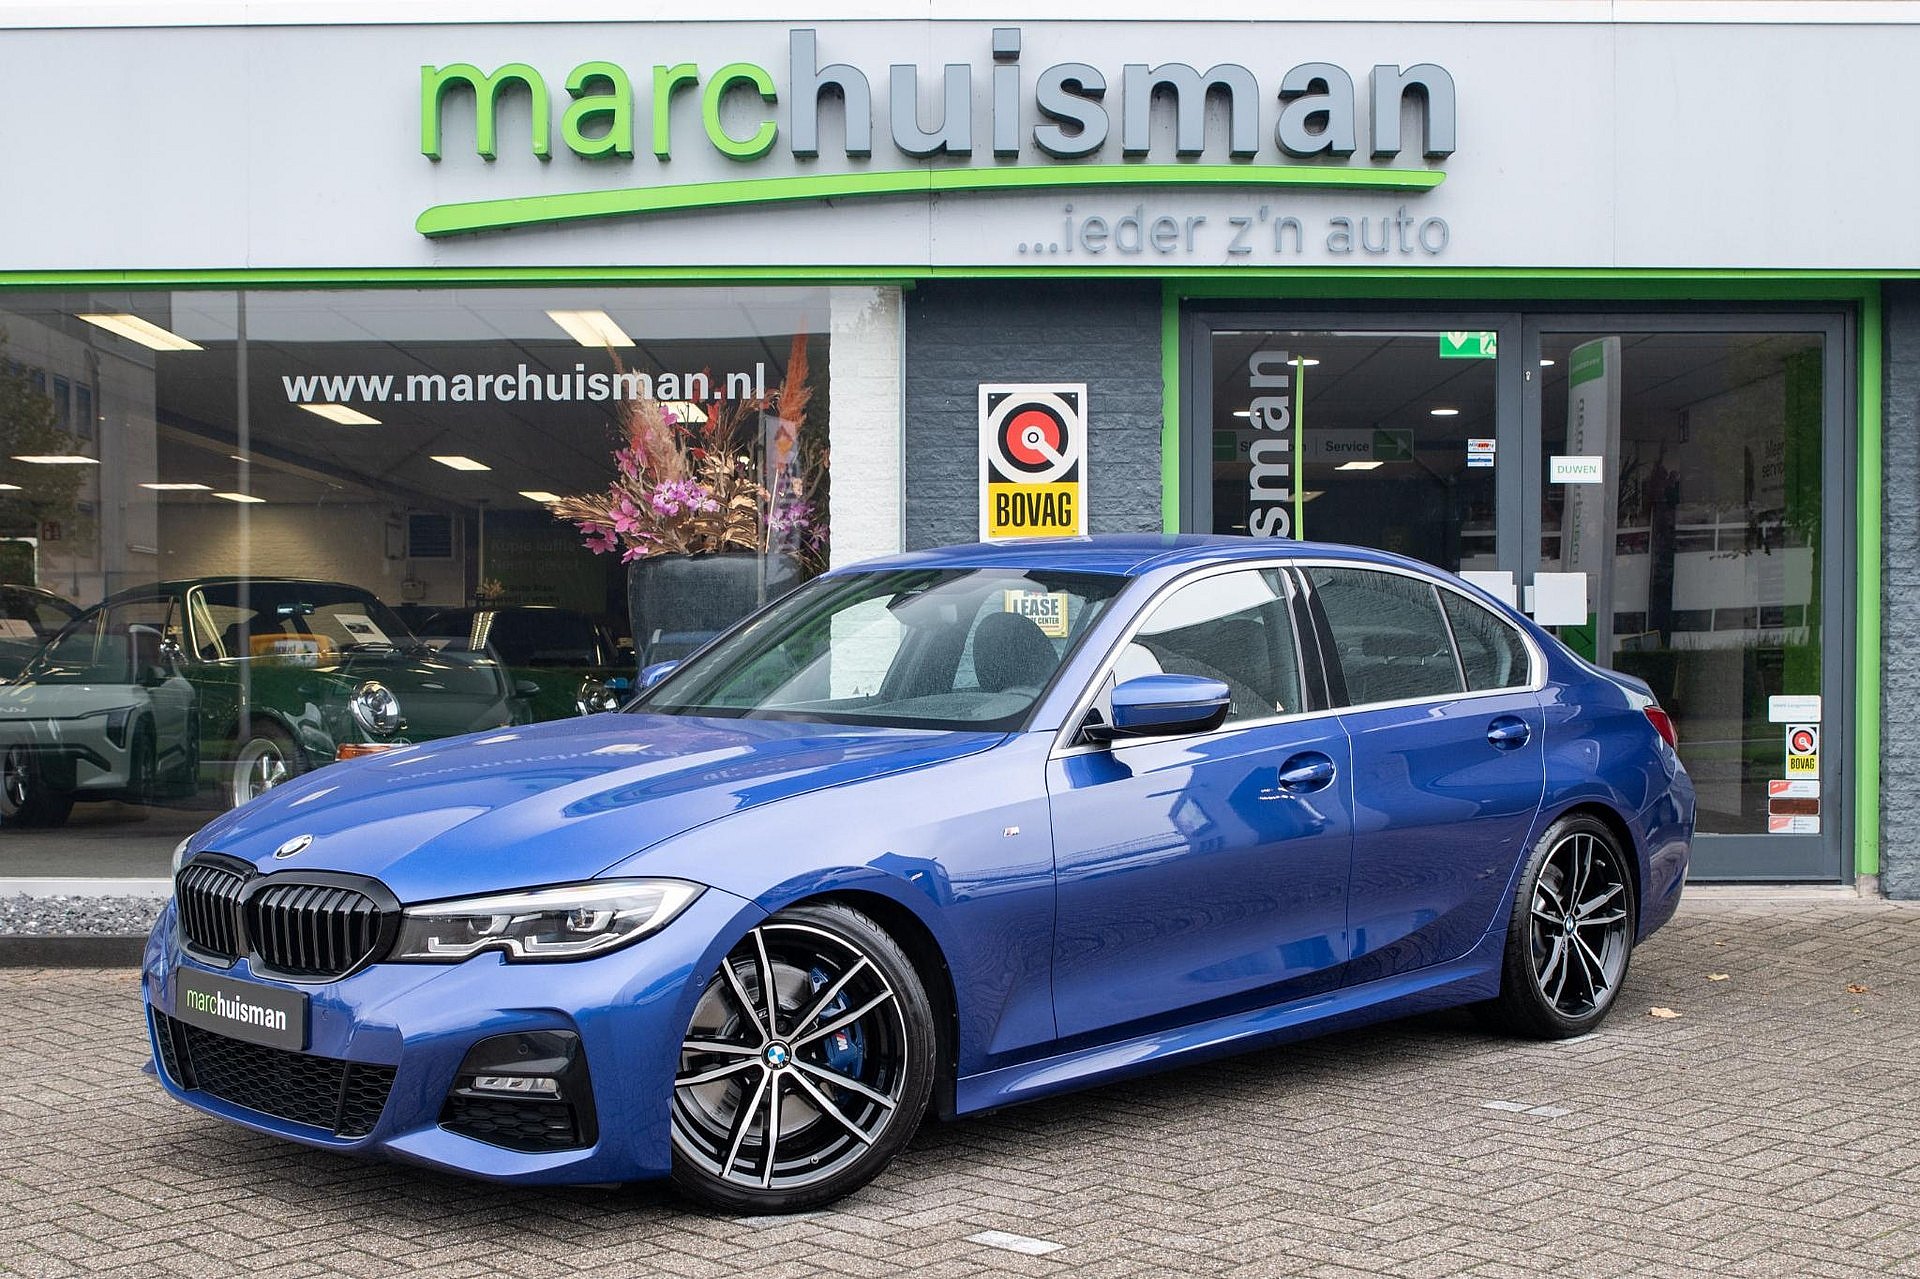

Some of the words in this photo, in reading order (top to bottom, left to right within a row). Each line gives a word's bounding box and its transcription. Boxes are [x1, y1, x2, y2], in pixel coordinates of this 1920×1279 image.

[421, 28, 1456, 162] marchuisman
[1017, 204, 1206, 254] ...ieder
[1228, 205, 1303, 254] z'n
[1326, 205, 1450, 254] auto
[282, 362, 766, 403] www.marchuisman.nl
[1325, 441, 1369, 452] Service
[1557, 464, 1597, 474] DUWEN
[996, 491, 1072, 527] BOVAG
[1790, 757, 1815, 770] BOVAG
[187, 989, 286, 1031] marchuisman
